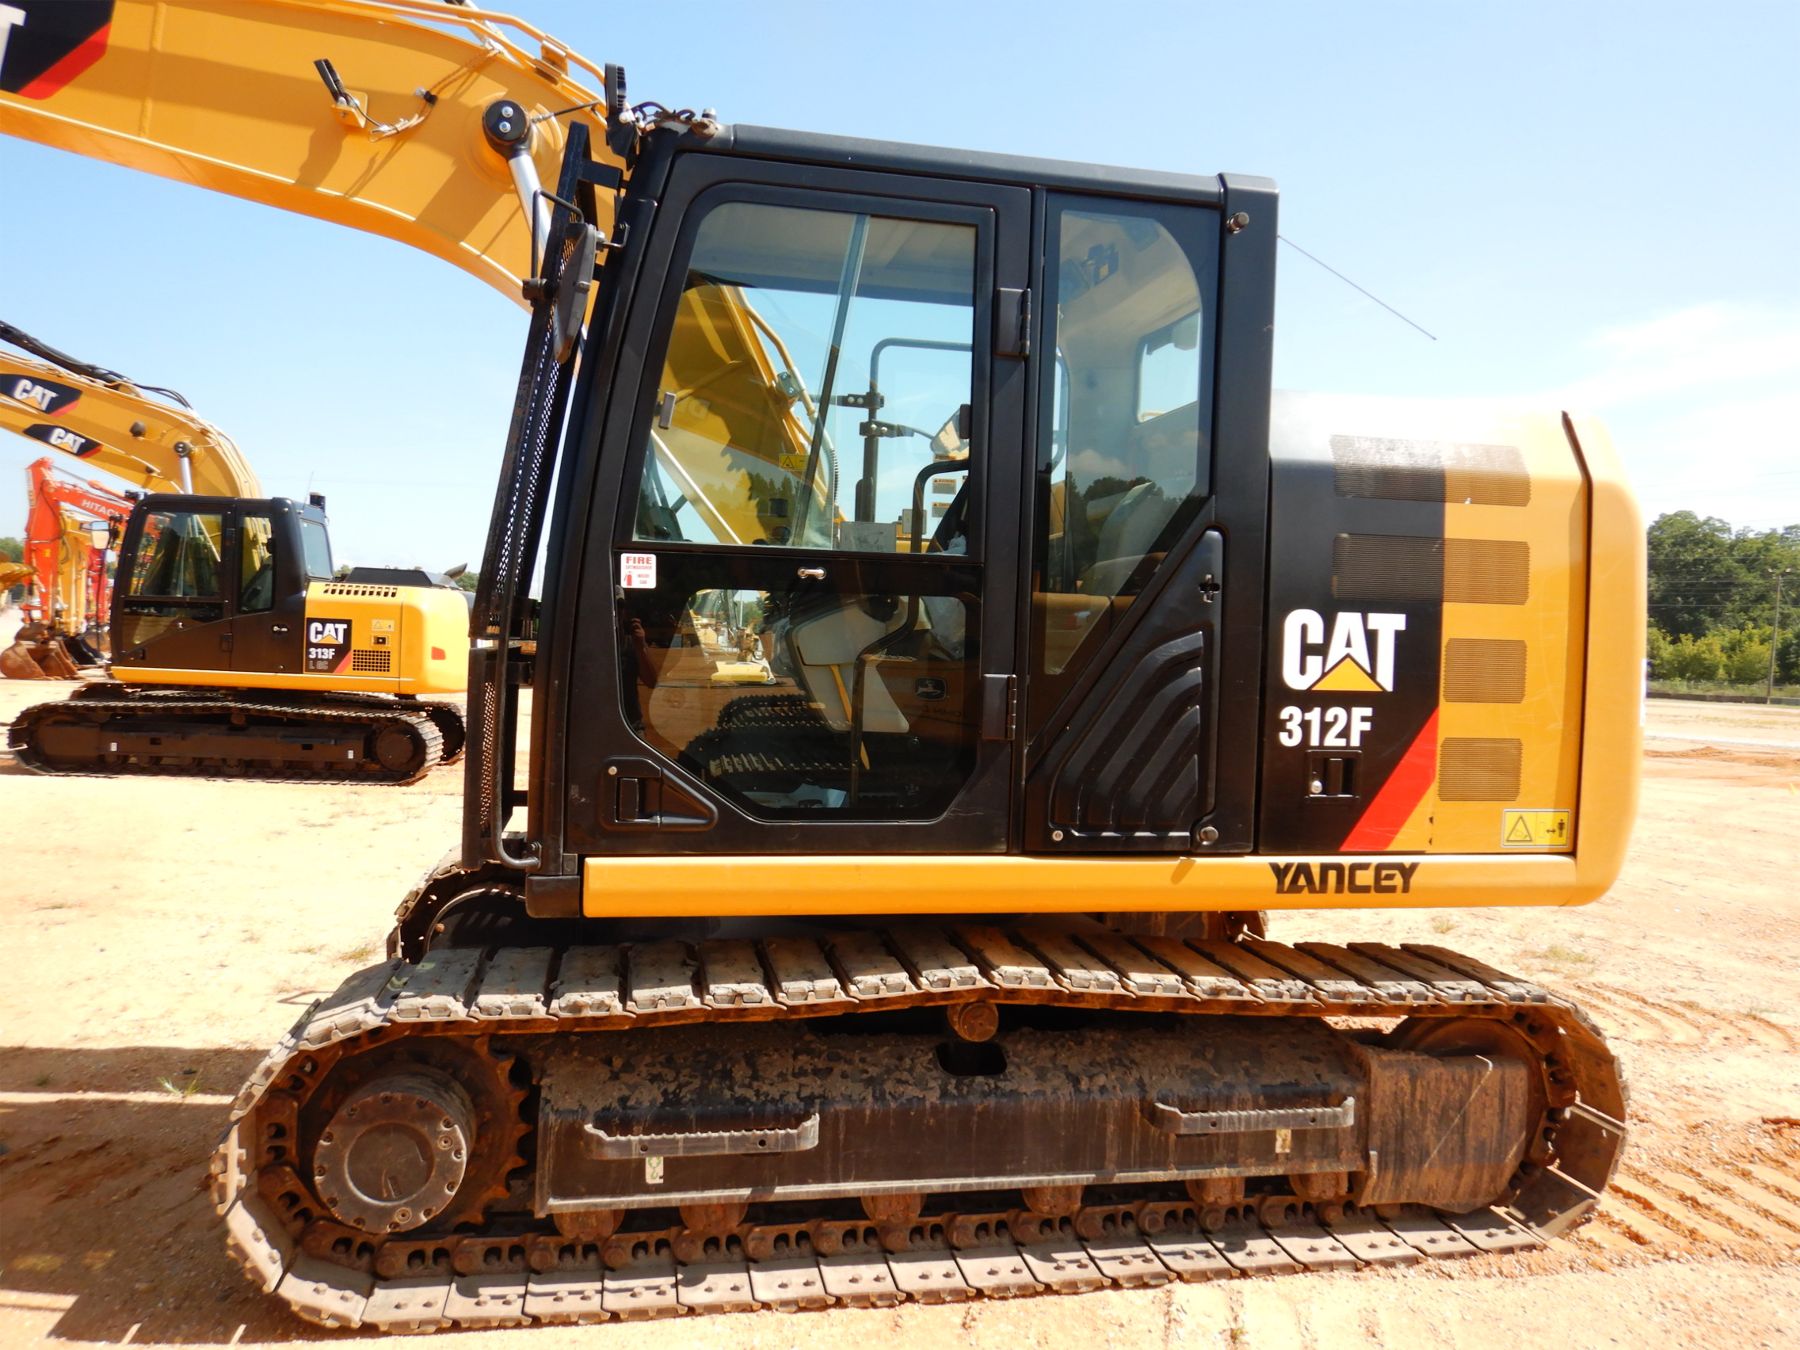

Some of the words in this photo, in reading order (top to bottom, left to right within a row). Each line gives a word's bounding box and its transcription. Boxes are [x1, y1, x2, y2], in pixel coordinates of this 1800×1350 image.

[14, 379, 58, 411] CAT
[50, 428, 86, 454] CAT
[626, 556, 652, 564] FIRE
[309, 622, 348, 645] CAT
[308, 647, 335, 659] 313F
[1282, 608, 1406, 692] CAT
[1279, 705, 1373, 747] 312F
[1268, 862, 1421, 894] YANCEY
